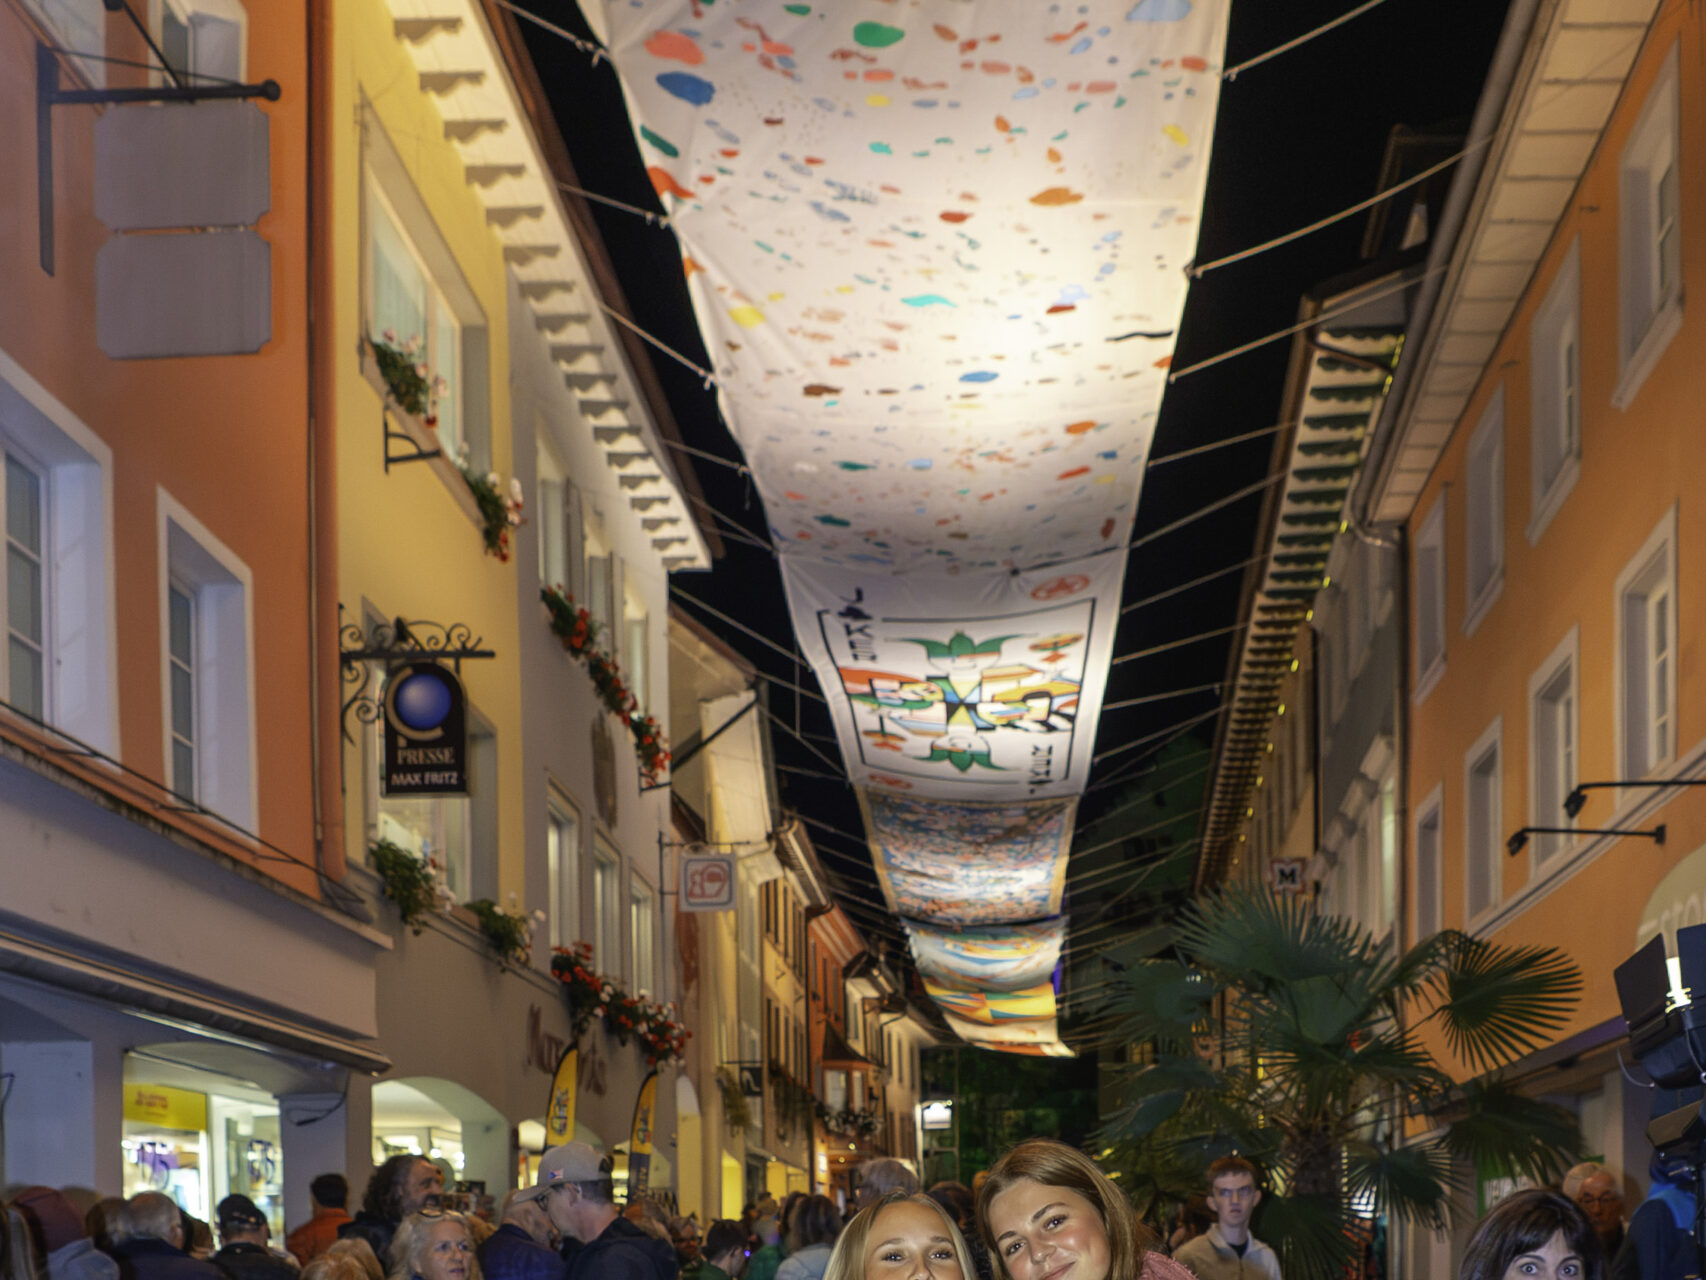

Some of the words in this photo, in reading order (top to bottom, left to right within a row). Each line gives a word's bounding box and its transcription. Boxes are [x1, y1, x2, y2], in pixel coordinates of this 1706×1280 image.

[397, 747, 455, 765] PRESSE
[391, 773, 422, 786] MAX
[424, 771, 458, 785] FRITZ
